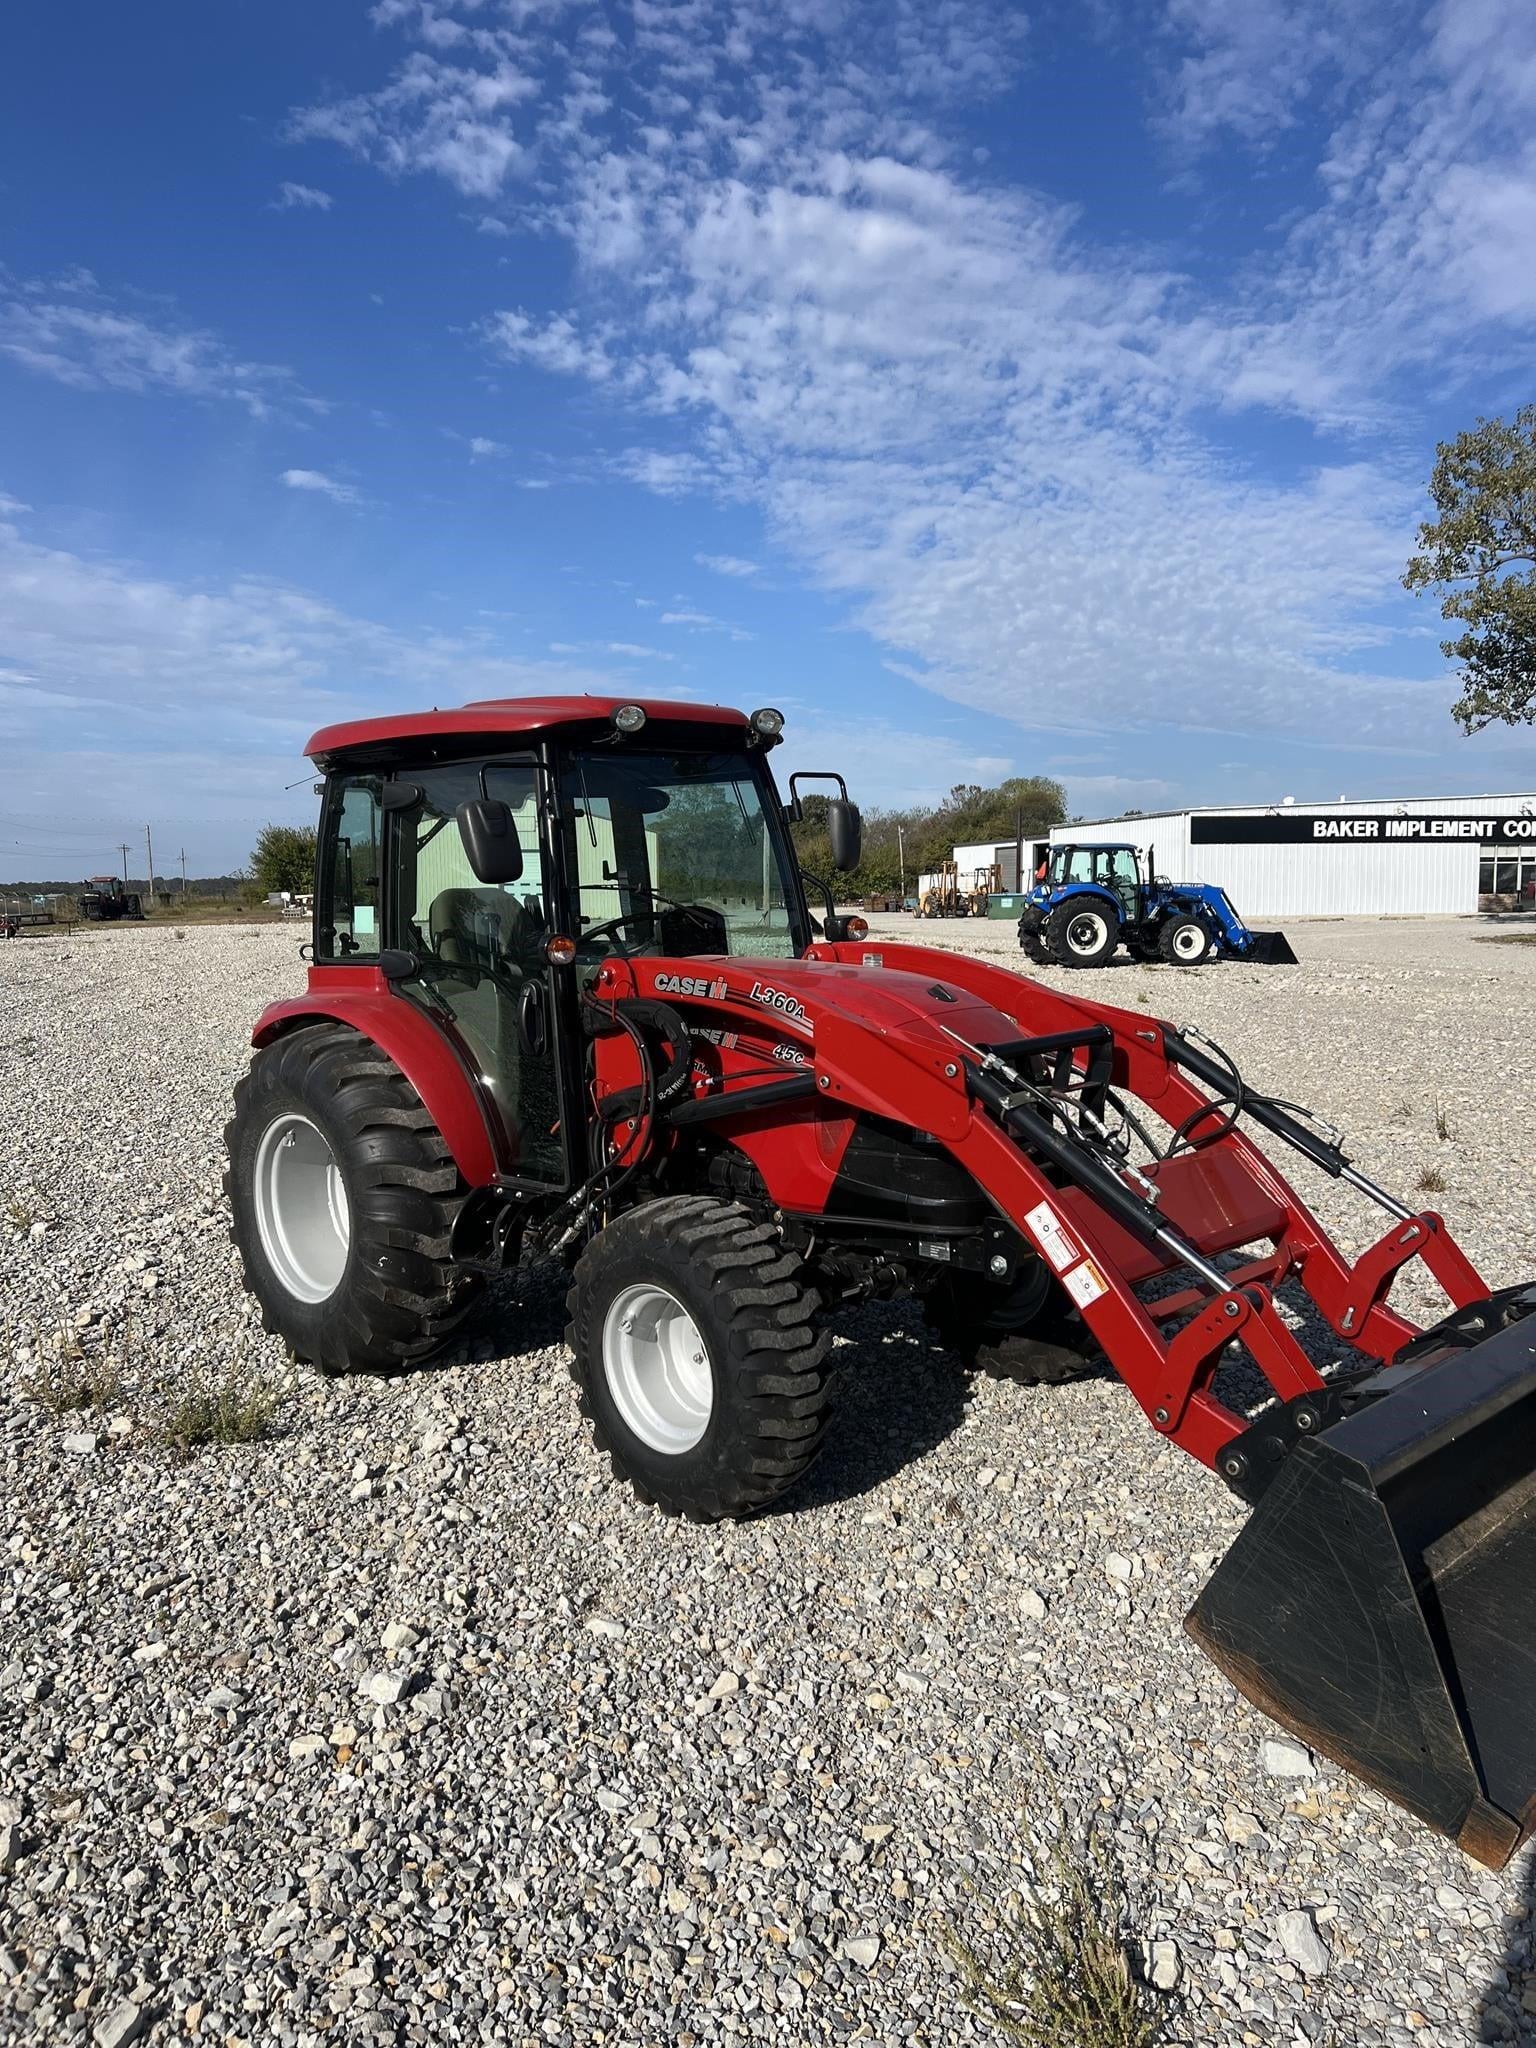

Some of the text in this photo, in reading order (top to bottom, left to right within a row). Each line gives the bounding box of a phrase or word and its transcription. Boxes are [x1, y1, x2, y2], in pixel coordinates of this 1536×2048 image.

[1313, 820, 1378, 837] BAKER
[1385, 820, 1497, 837] IMPLEMENT
[654, 973, 708, 998] CASE
[749, 982, 805, 1020] L360A
